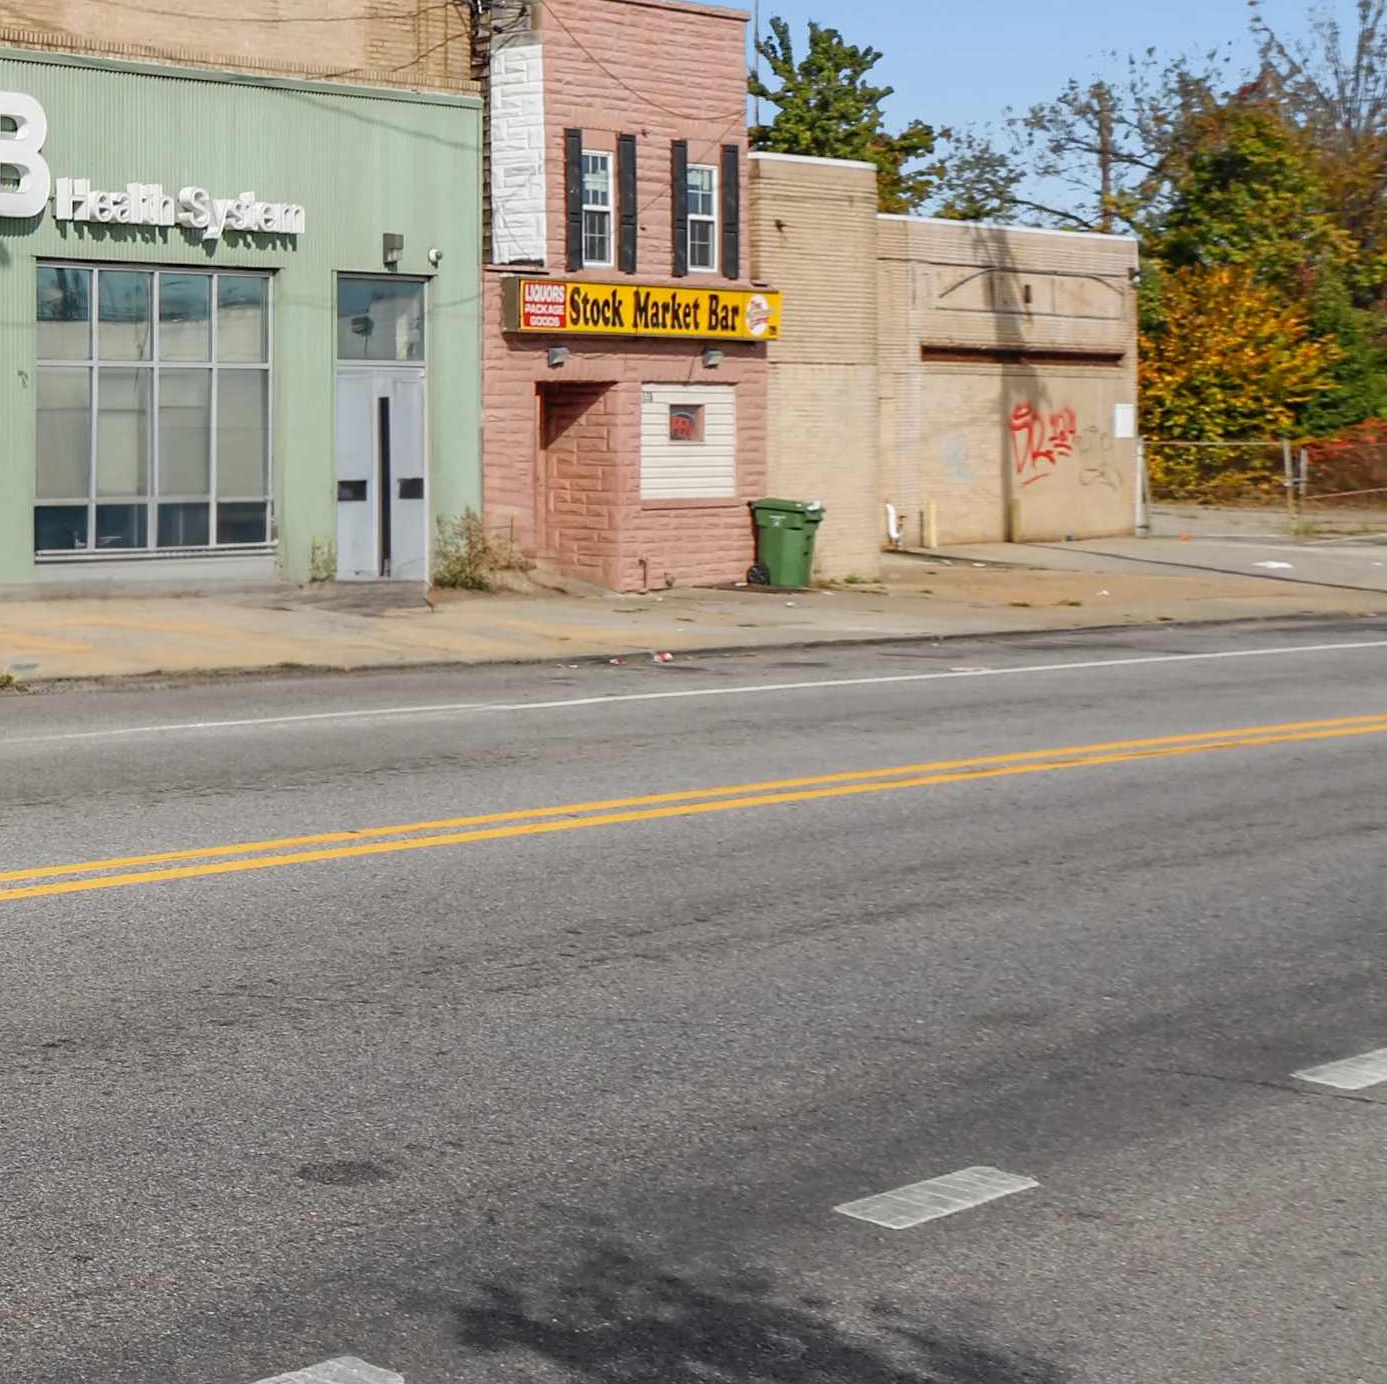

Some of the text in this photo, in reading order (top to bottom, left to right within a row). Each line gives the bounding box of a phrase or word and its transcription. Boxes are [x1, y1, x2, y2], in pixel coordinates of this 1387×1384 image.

[56, 177, 305, 239] Health System
[525, 283, 565, 303] LIQUORS
[525, 303, 564, 315] PACKAGE
[569, 286, 624, 327] Stock
[632, 290, 700, 330] Market
[707, 294, 739, 331] Bar
[530, 315, 560, 327] GOODS
